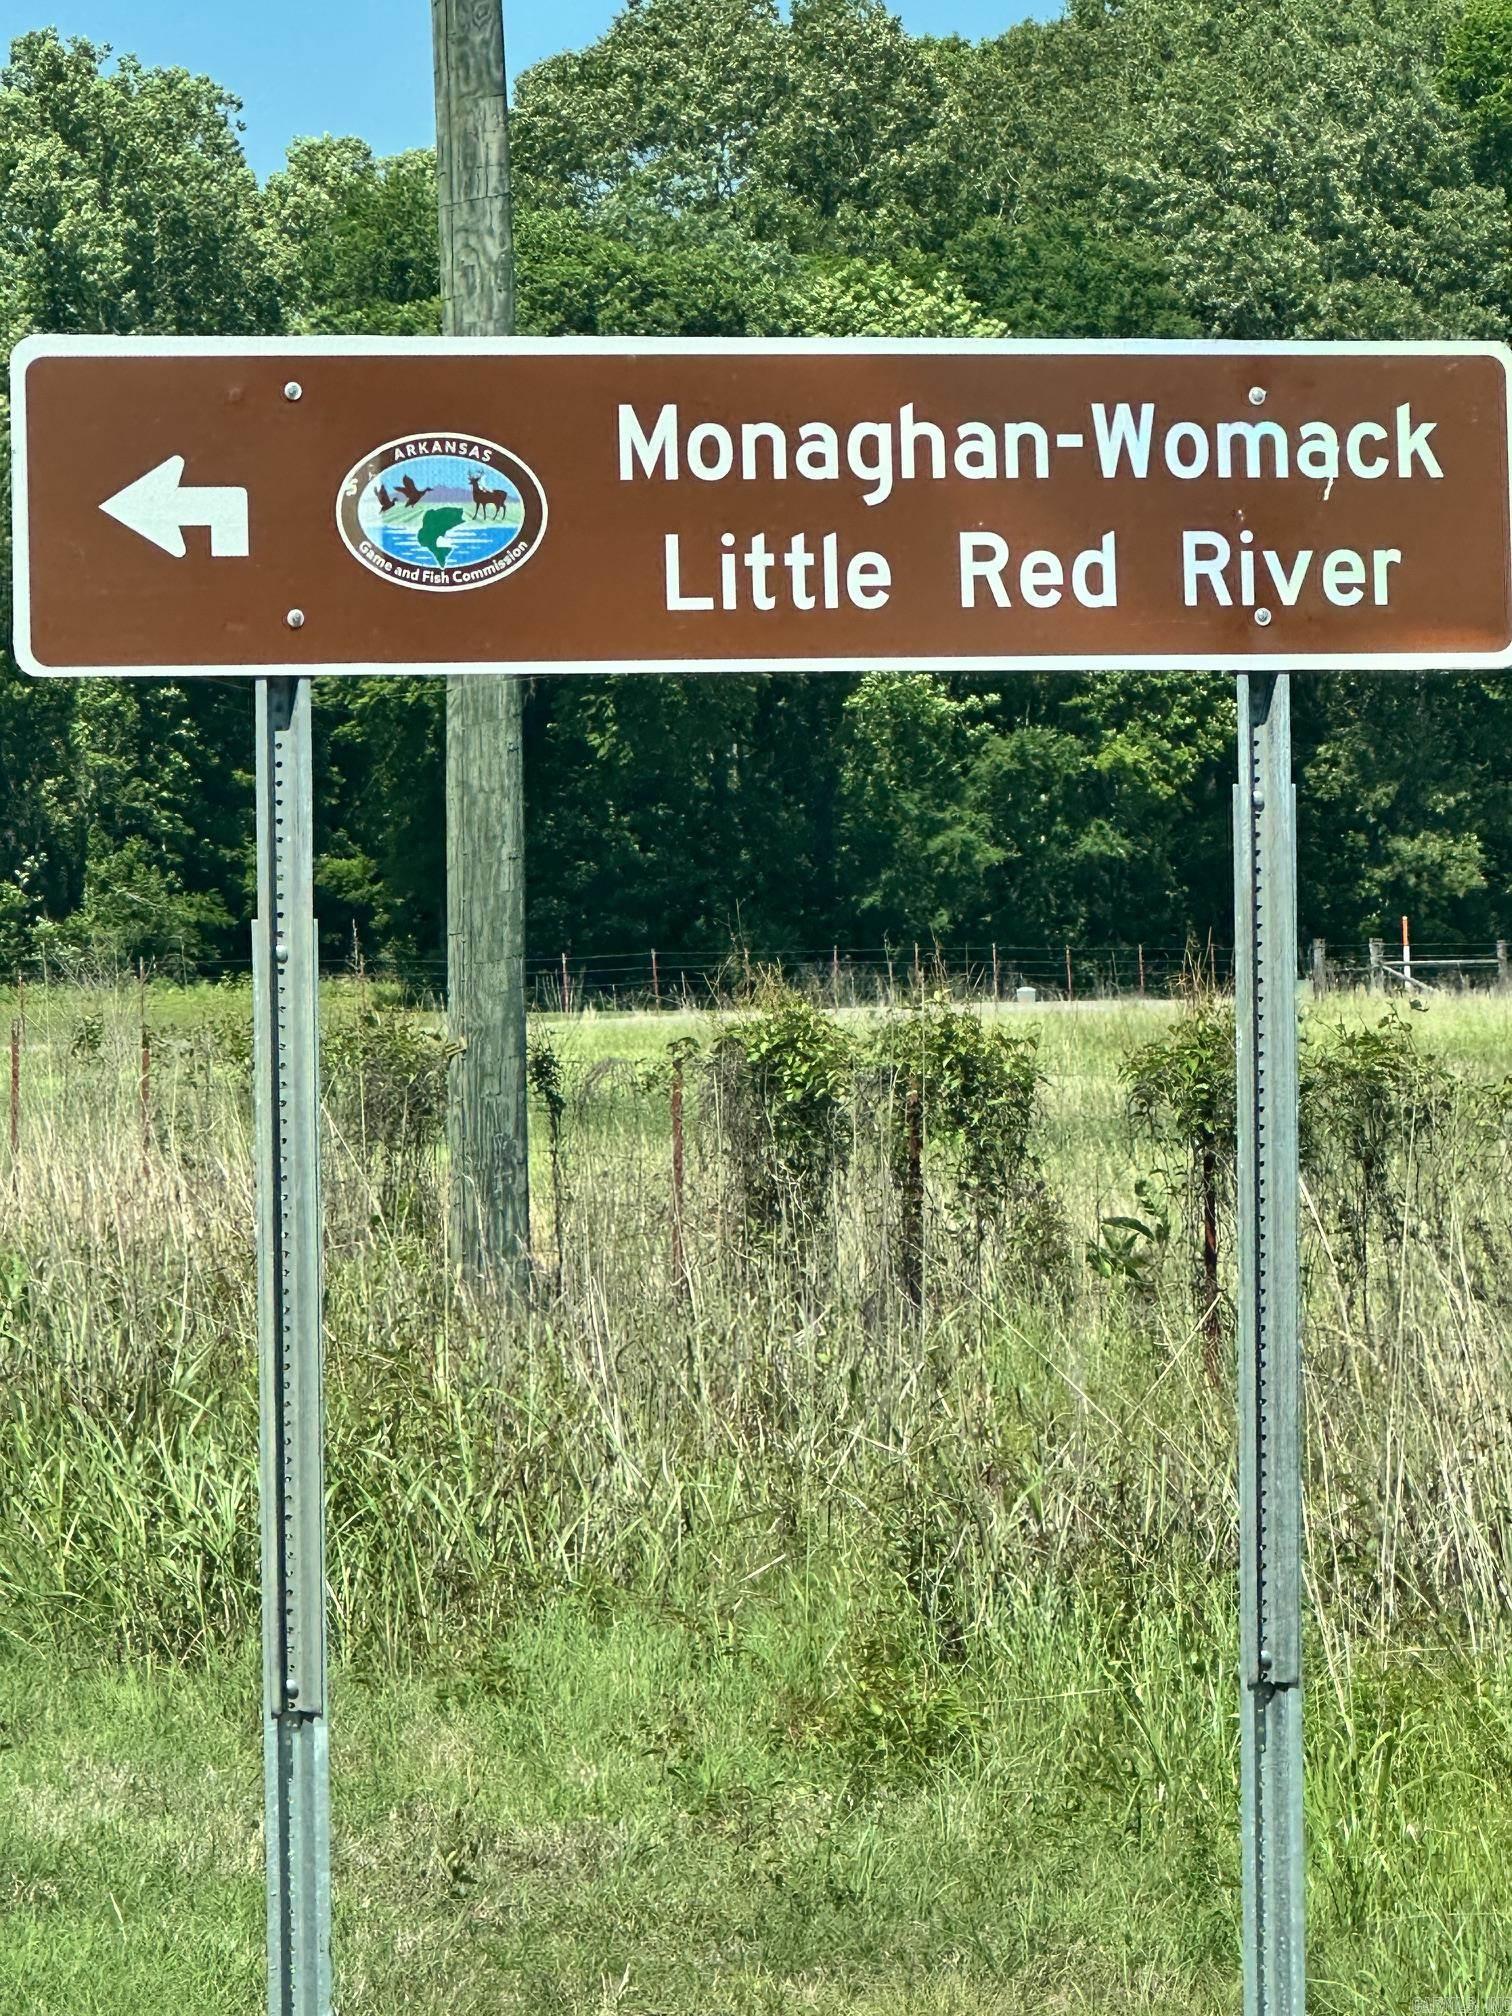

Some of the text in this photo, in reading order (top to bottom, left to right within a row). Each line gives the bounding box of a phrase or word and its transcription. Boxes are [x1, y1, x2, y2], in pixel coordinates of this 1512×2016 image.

[394, 440, 493, 462] ARKANSAS
[618, 402, 1445, 506] Monaghan-Womack
[358, 540, 529, 584] Game and Fish Commission
[664, 530, 1402, 611] Little Red River
